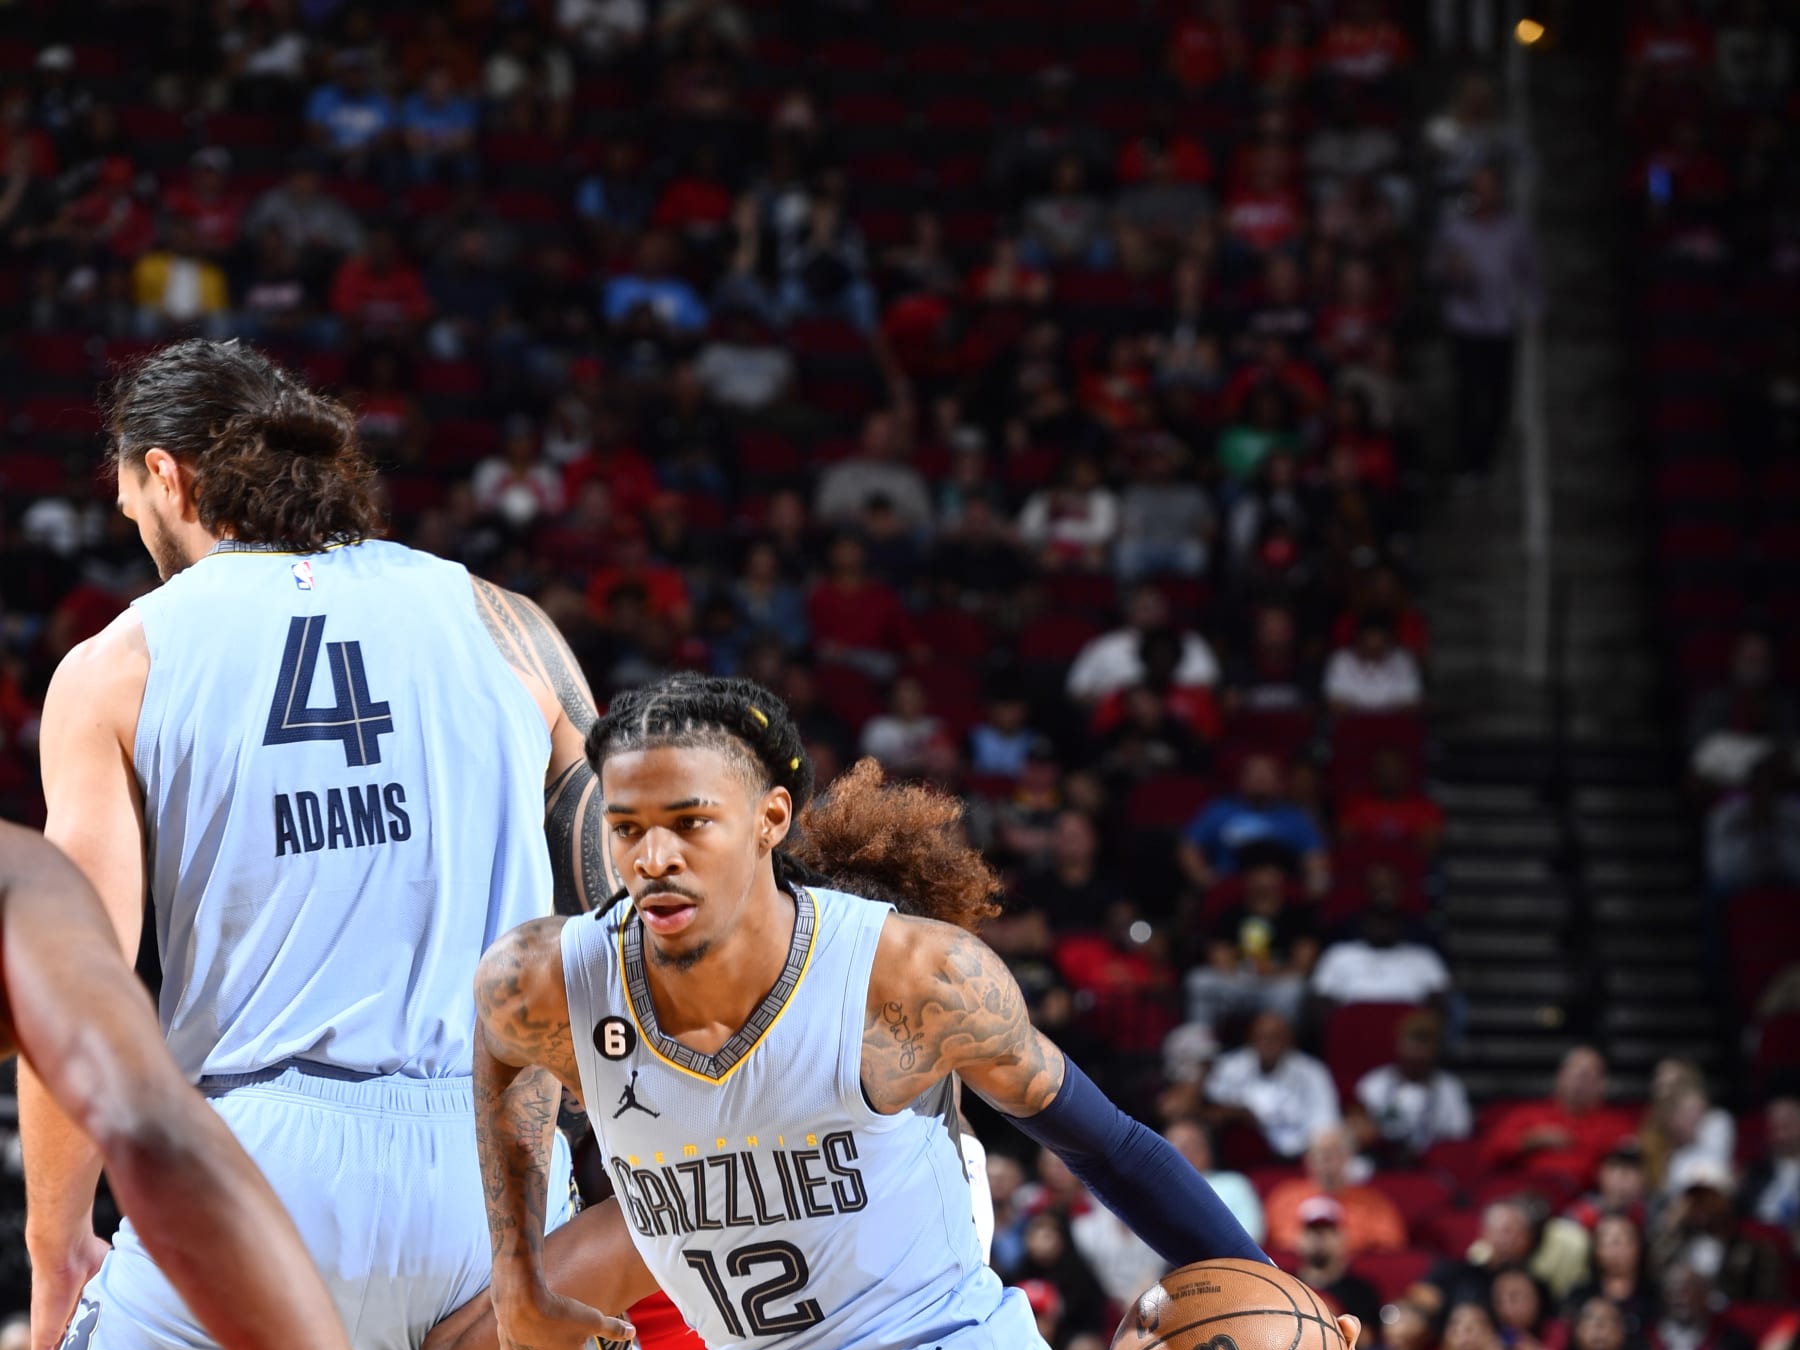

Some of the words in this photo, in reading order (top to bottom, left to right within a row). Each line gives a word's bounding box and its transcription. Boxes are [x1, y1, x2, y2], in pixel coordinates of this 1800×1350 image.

[262, 614, 394, 768] 4
[273, 782, 412, 858] ADAMS
[604, 1021, 626, 1056] 6
[610, 1129, 869, 1237] GRIZZLIES
[627, 1133, 818, 1166] MEMPHIS
[682, 1239, 826, 1340] 12
